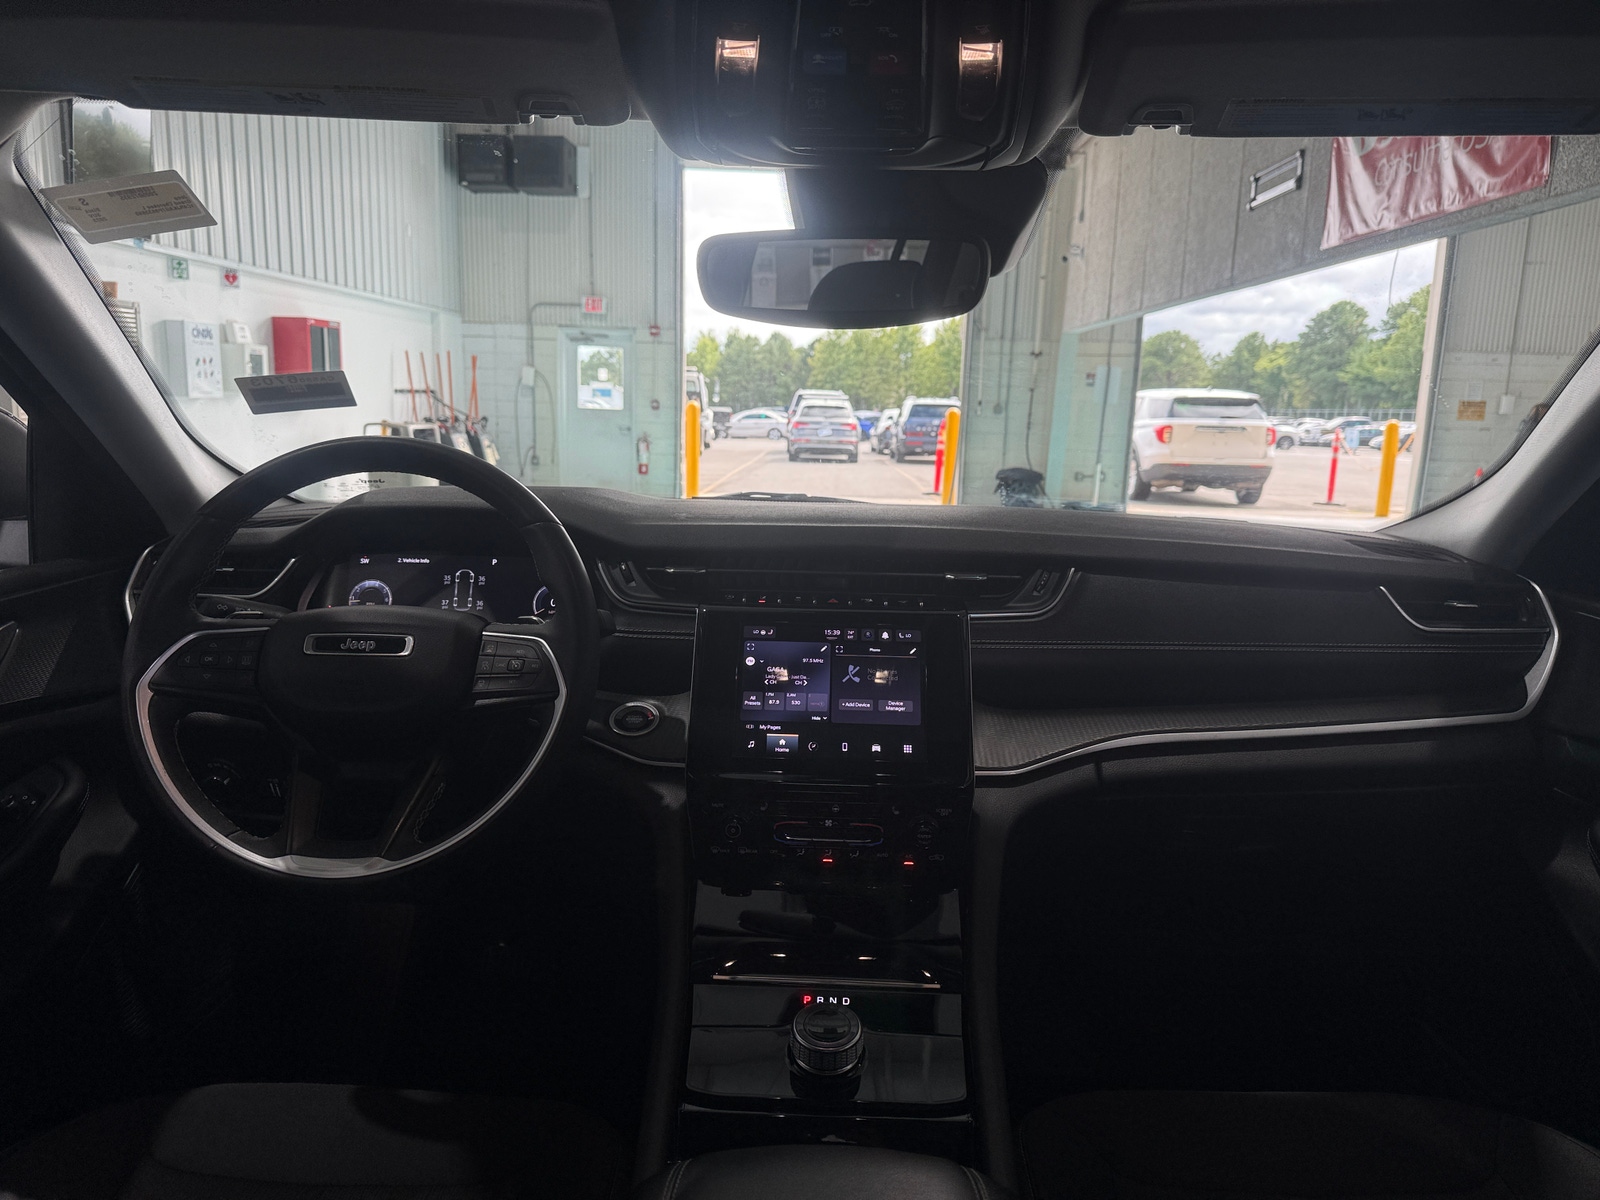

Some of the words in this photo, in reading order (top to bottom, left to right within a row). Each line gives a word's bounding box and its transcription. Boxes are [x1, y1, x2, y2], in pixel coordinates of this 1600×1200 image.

[491, 558, 498, 566] P
[340, 637, 376, 652] Jeep
[803, 995, 812, 1004] P
[816, 996, 824, 1004] R
[829, 996, 837, 1004] N
[842, 997, 850, 1005] D
